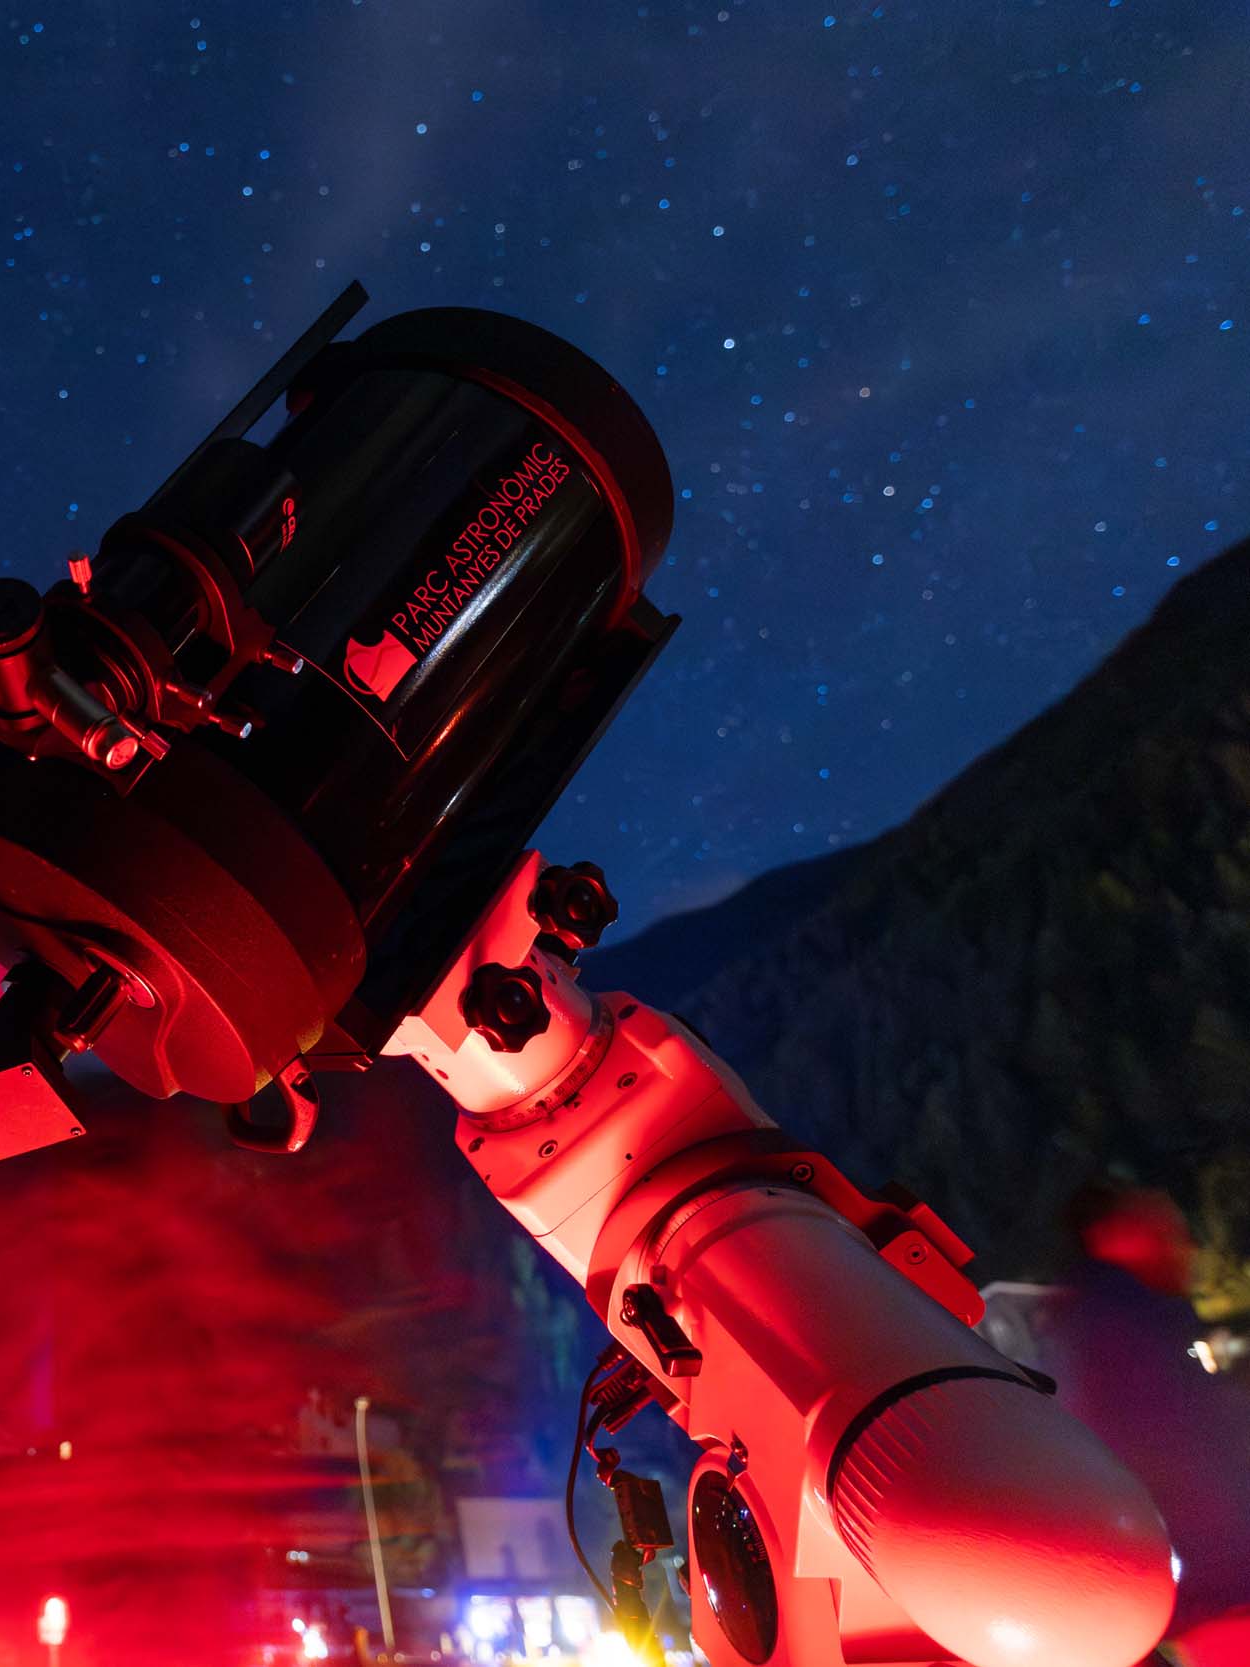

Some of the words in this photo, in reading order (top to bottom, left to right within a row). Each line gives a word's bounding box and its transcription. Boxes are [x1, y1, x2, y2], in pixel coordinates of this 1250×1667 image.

[392, 570, 449, 635] PARC
[445, 443, 553, 577] ASTRONÒMIC
[412, 544, 500, 653] MUNTANYES
[494, 518, 522, 548] DE
[514, 457, 570, 525] PRADES
